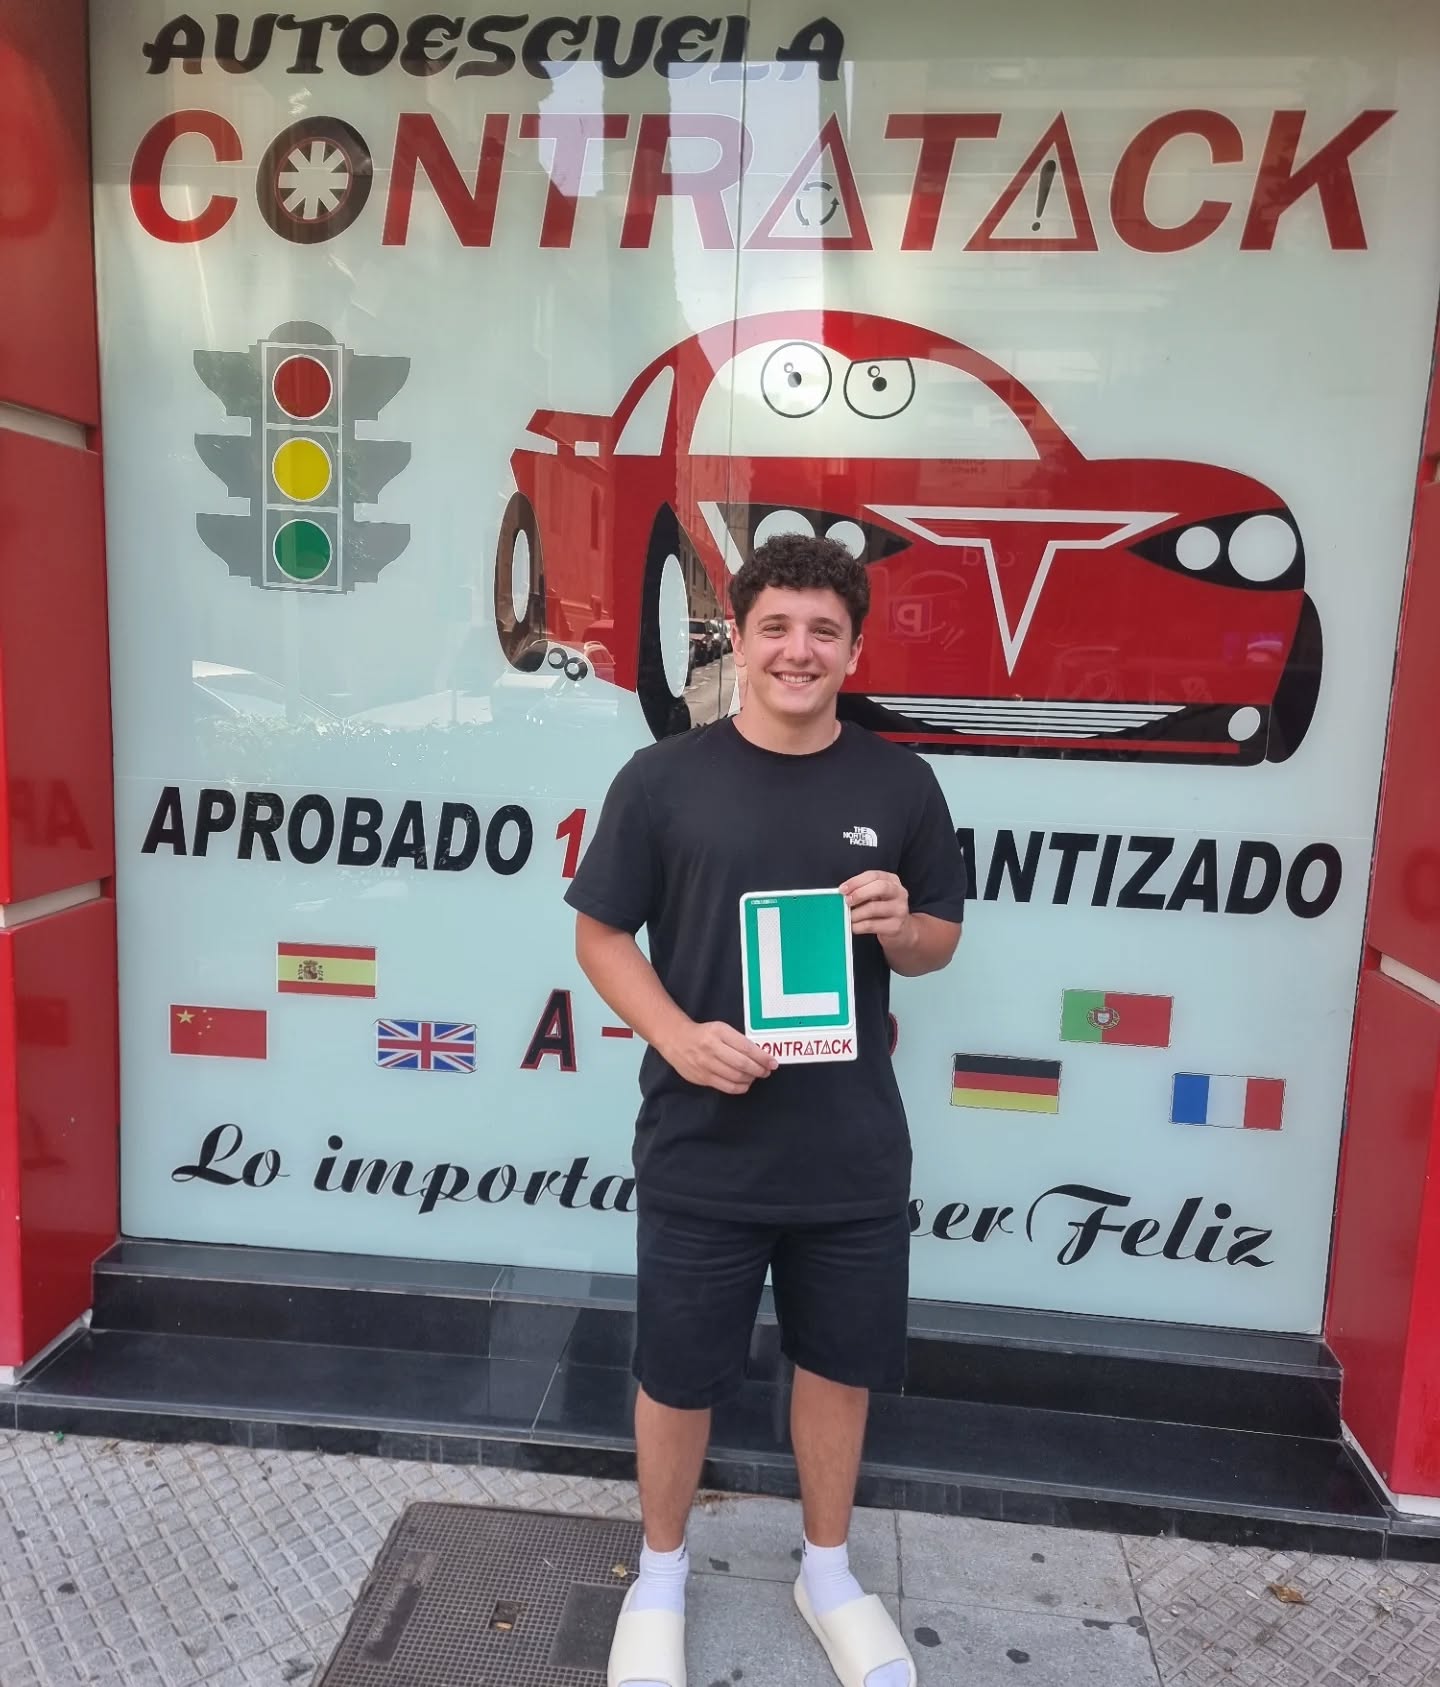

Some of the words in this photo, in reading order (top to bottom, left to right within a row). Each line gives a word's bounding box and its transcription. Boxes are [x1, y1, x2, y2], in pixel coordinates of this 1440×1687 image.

[142, 13, 846, 84] AUTOESCUELA
[129, 109, 1399, 253] CONTRATACK
[141, 786, 533, 876] APROBADO
[756, 906, 840, 1019] L
[171, 1123, 290, 1188] Lo
[1025, 1183, 1275, 1268] Feliz
